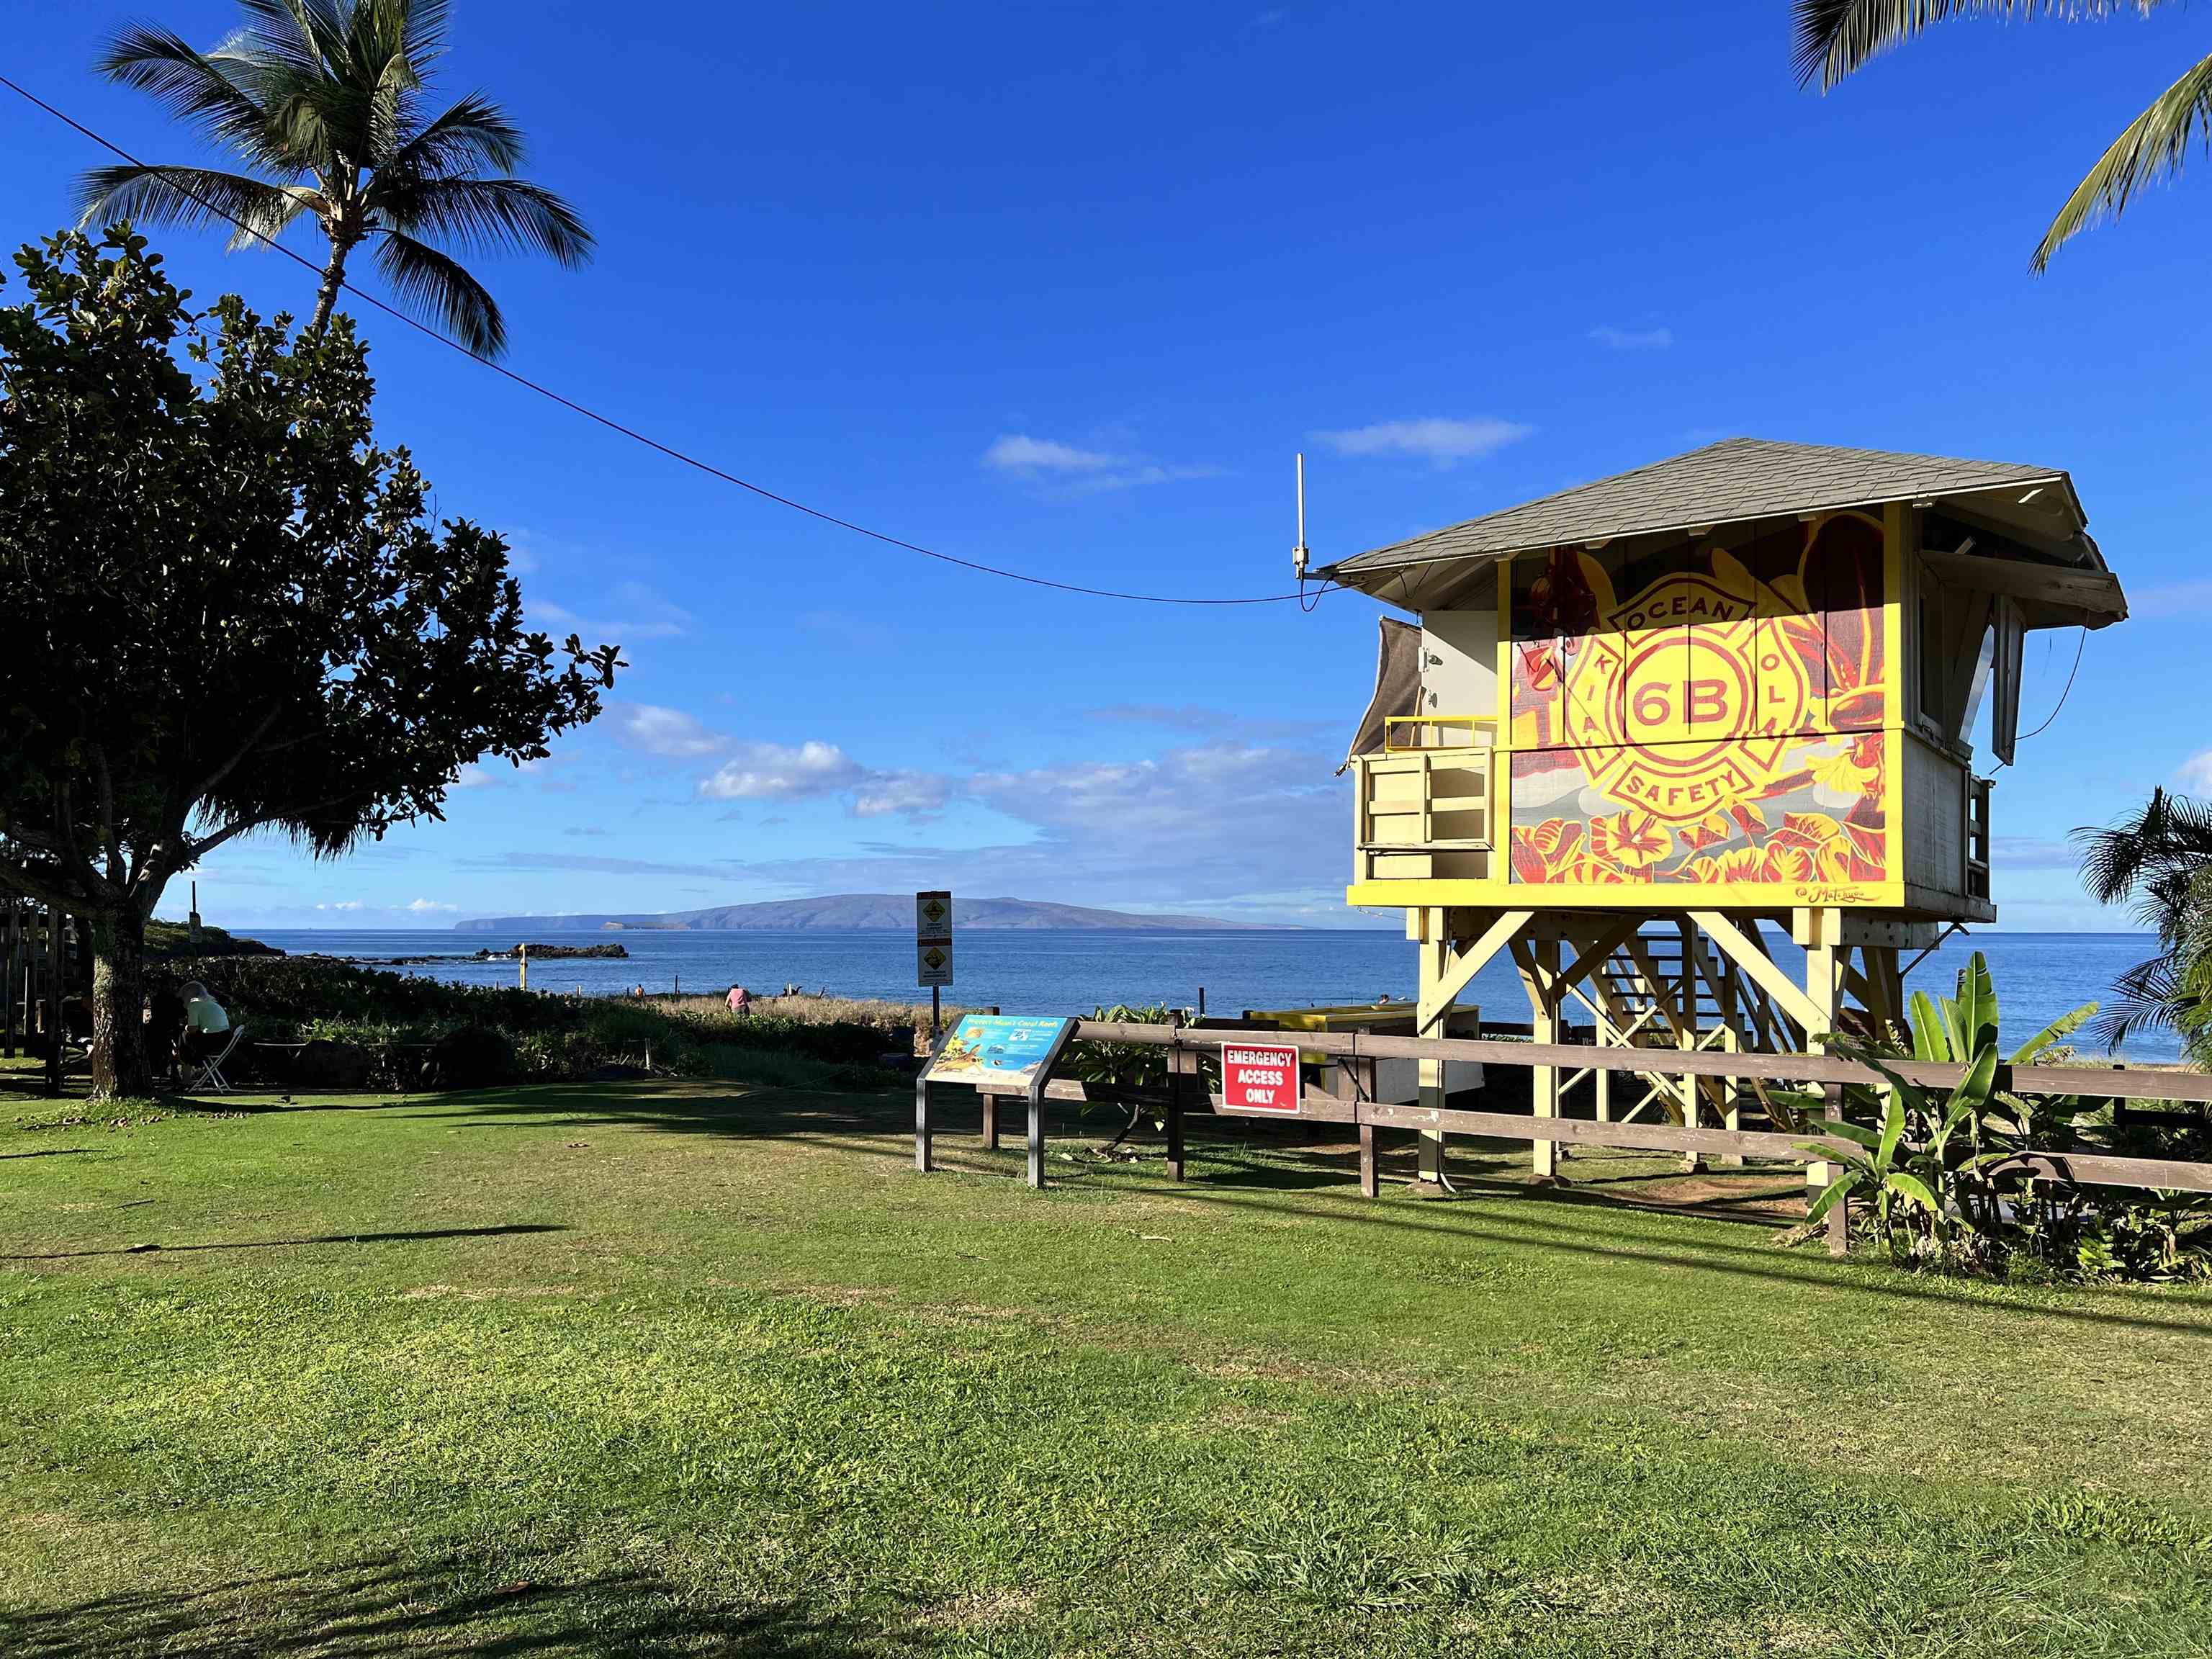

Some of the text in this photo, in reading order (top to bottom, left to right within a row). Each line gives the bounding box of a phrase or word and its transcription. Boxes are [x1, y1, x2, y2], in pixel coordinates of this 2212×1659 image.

[1627, 596, 1734, 630] OCEAN
[1633, 679, 1729, 726] 6B
[1753, 654, 1786, 742] OLA
[1626, 770, 1736, 806] SAFETY
[1227, 1050, 1292, 1067] EMERGENCY
[1238, 1069, 1283, 1086] ACCESS
[1246, 1088, 1275, 1104] ONLY
